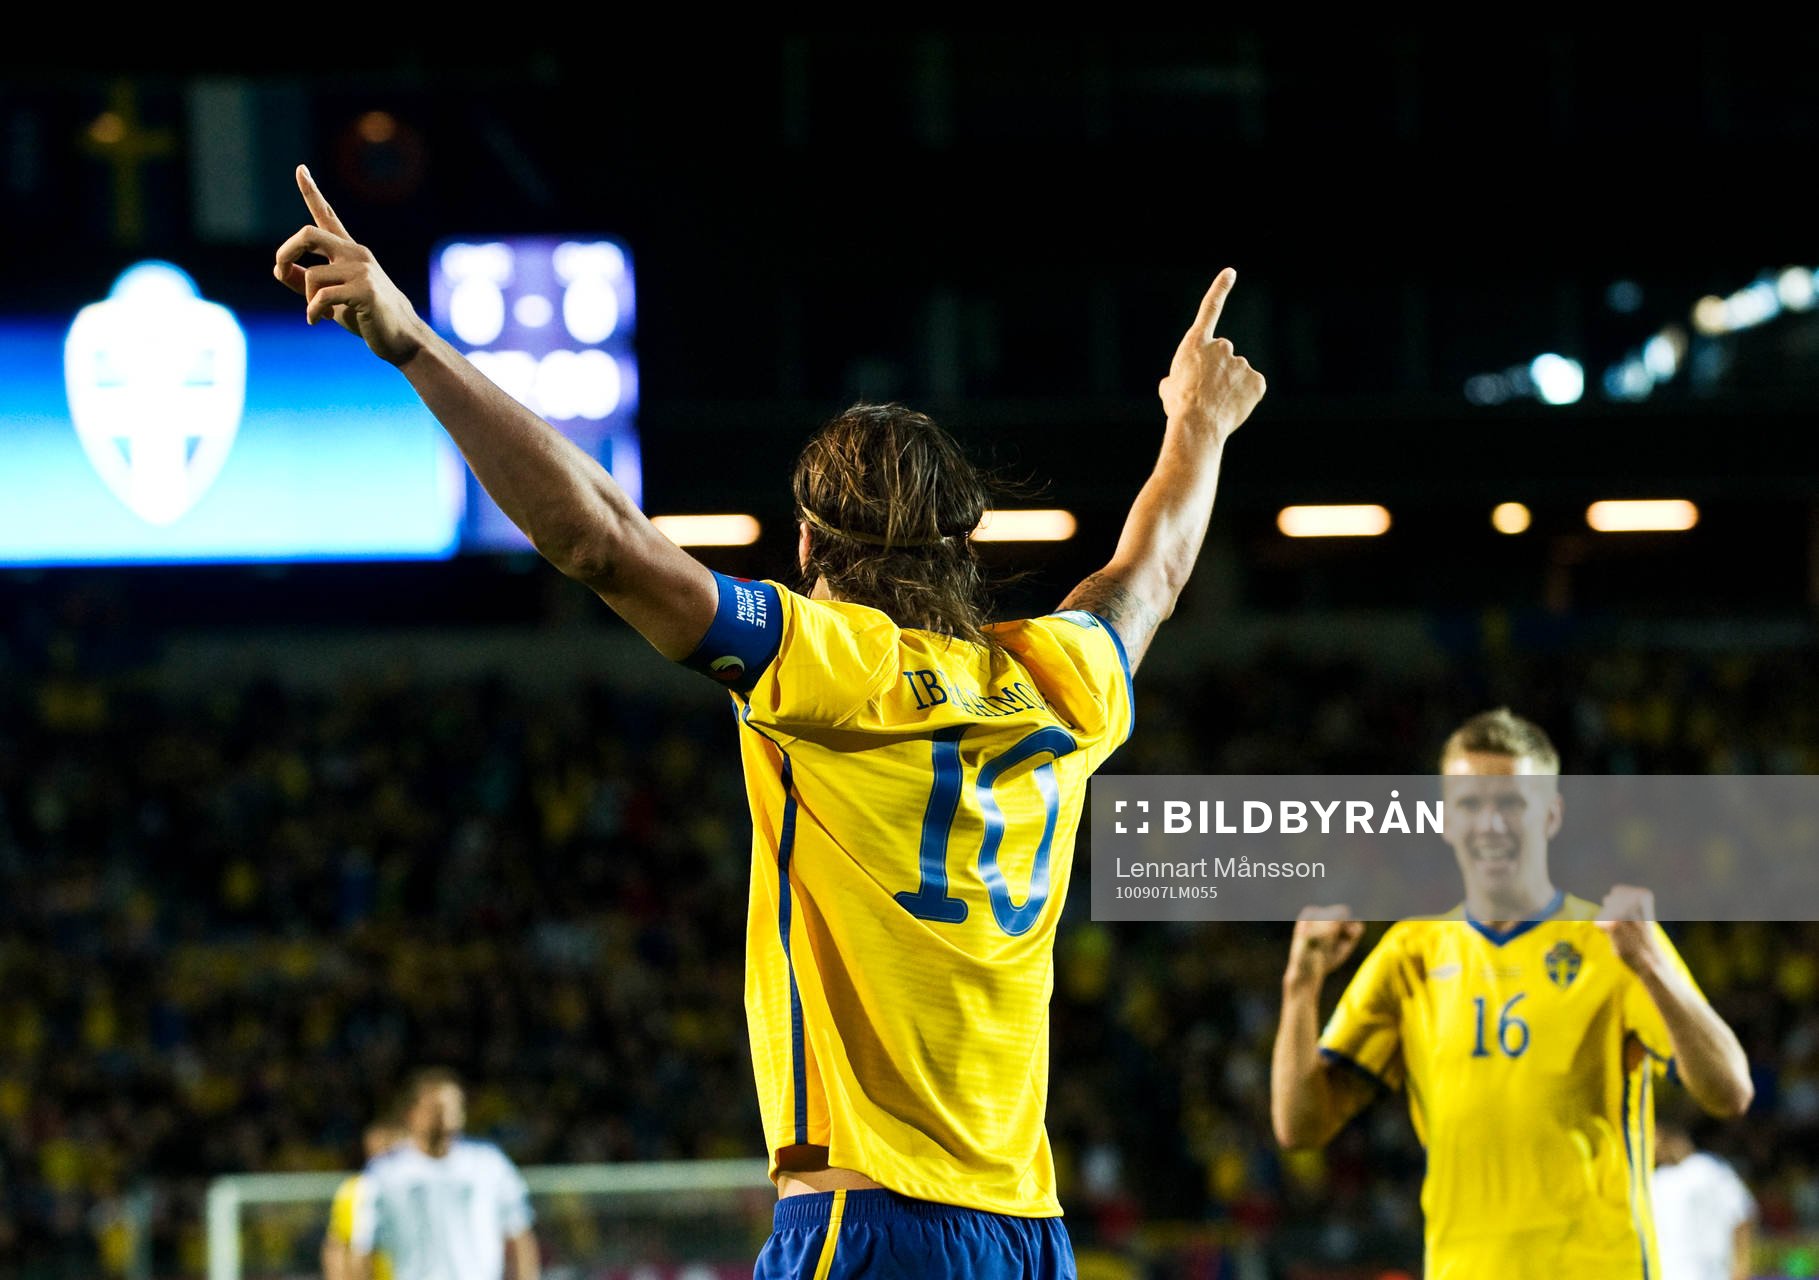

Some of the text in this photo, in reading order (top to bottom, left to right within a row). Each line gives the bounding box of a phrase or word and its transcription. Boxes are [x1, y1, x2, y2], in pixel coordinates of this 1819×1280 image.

[733, 584, 747, 621] RACISM
[743, 588, 756, 625] AGAINST
[754, 590, 767, 629] UNITE
[894, 722, 1078, 936] 10
[1471, 992, 1531, 1060] 16
